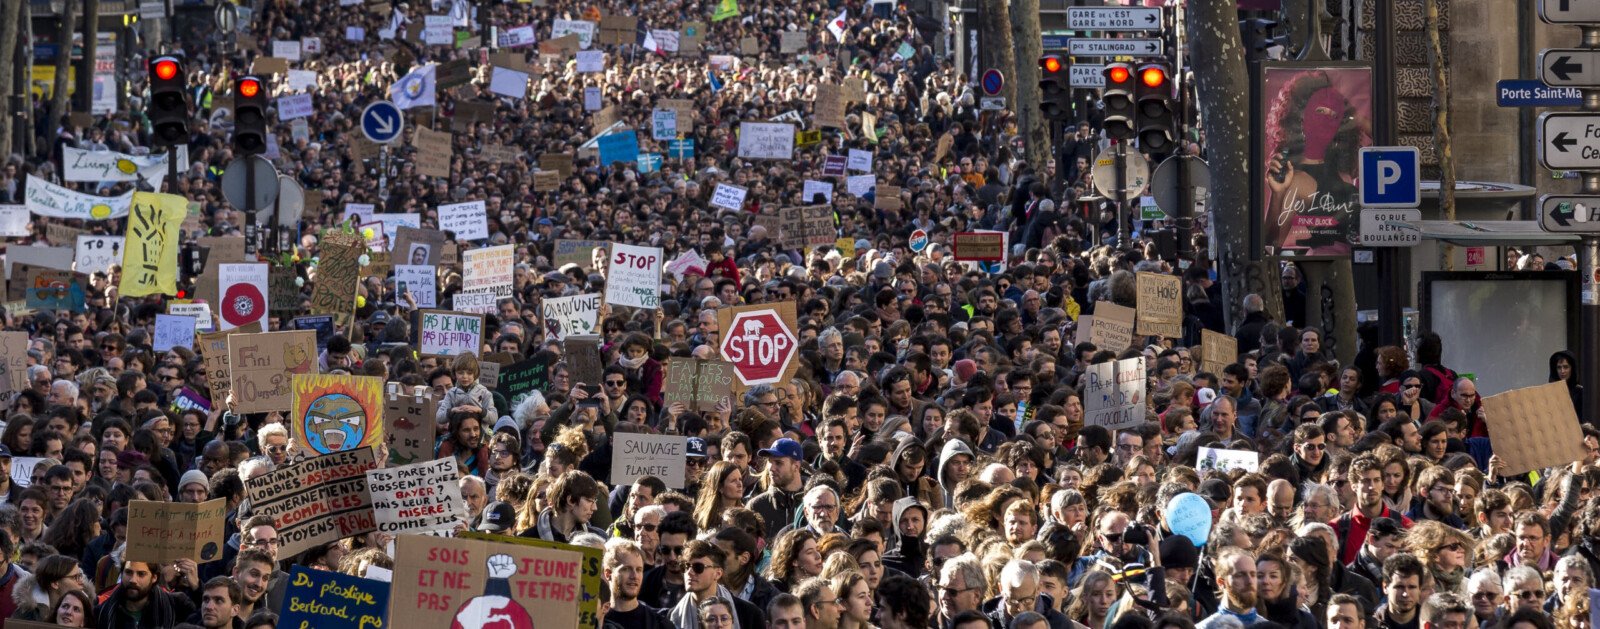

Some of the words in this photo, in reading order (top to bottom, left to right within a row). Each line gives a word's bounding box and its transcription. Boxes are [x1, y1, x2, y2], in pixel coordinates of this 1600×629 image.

[1501, 88, 1531, 99] Porte
[1376, 160, 1401, 195] P
[1277, 187, 1305, 226] Yes
[84, 239, 104, 250] TO
[614, 252, 656, 271] STOP
[632, 286, 655, 295] MONDE
[1157, 286, 1179, 300] HONEY
[455, 293, 496, 306] ARRETEZ
[424, 314, 439, 330] PAS
[441, 316, 452, 332] DE
[454, 317, 480, 335] NATURE
[422, 330, 436, 346] PAS
[438, 332, 449, 346] DE
[450, 332, 472, 349] FUTUR
[730, 332, 788, 366] STOP
[671, 360, 724, 376] FAITES
[531, 378, 541, 386] OU
[667, 392, 721, 403] MAGASINS
[1102, 393, 1117, 409] PAS
[1119, 390, 1130, 406] DE
[407, 406, 422, 416] DE
[1093, 406, 1135, 426] CHOCOLAT
[404, 438, 420, 448] DE
[624, 439, 681, 456] SAUVAGE
[371, 472, 393, 481] TES
[397, 461, 453, 479] PARENTS
[625, 464, 669, 476] PLANETE
[370, 478, 424, 492] BOSSENT
[427, 473, 459, 485] CHEZ
[395, 487, 435, 500] BAYER
[374, 499, 399, 510] FAIS
[402, 497, 431, 508] LEUR
[435, 495, 452, 504] LA
[130, 508, 147, 519] IL
[378, 519, 428, 532] COMME
[435, 514, 458, 526] ILS
[141, 526, 173, 539] PATCH
[427, 547, 471, 566] SOIS
[516, 557, 579, 580] JEUNE
[417, 568, 439, 588] ET
[443, 570, 472, 590] NE
[292, 572, 314, 588] Du
[319, 580, 377, 606] plastique
[416, 592, 453, 611] PAS
